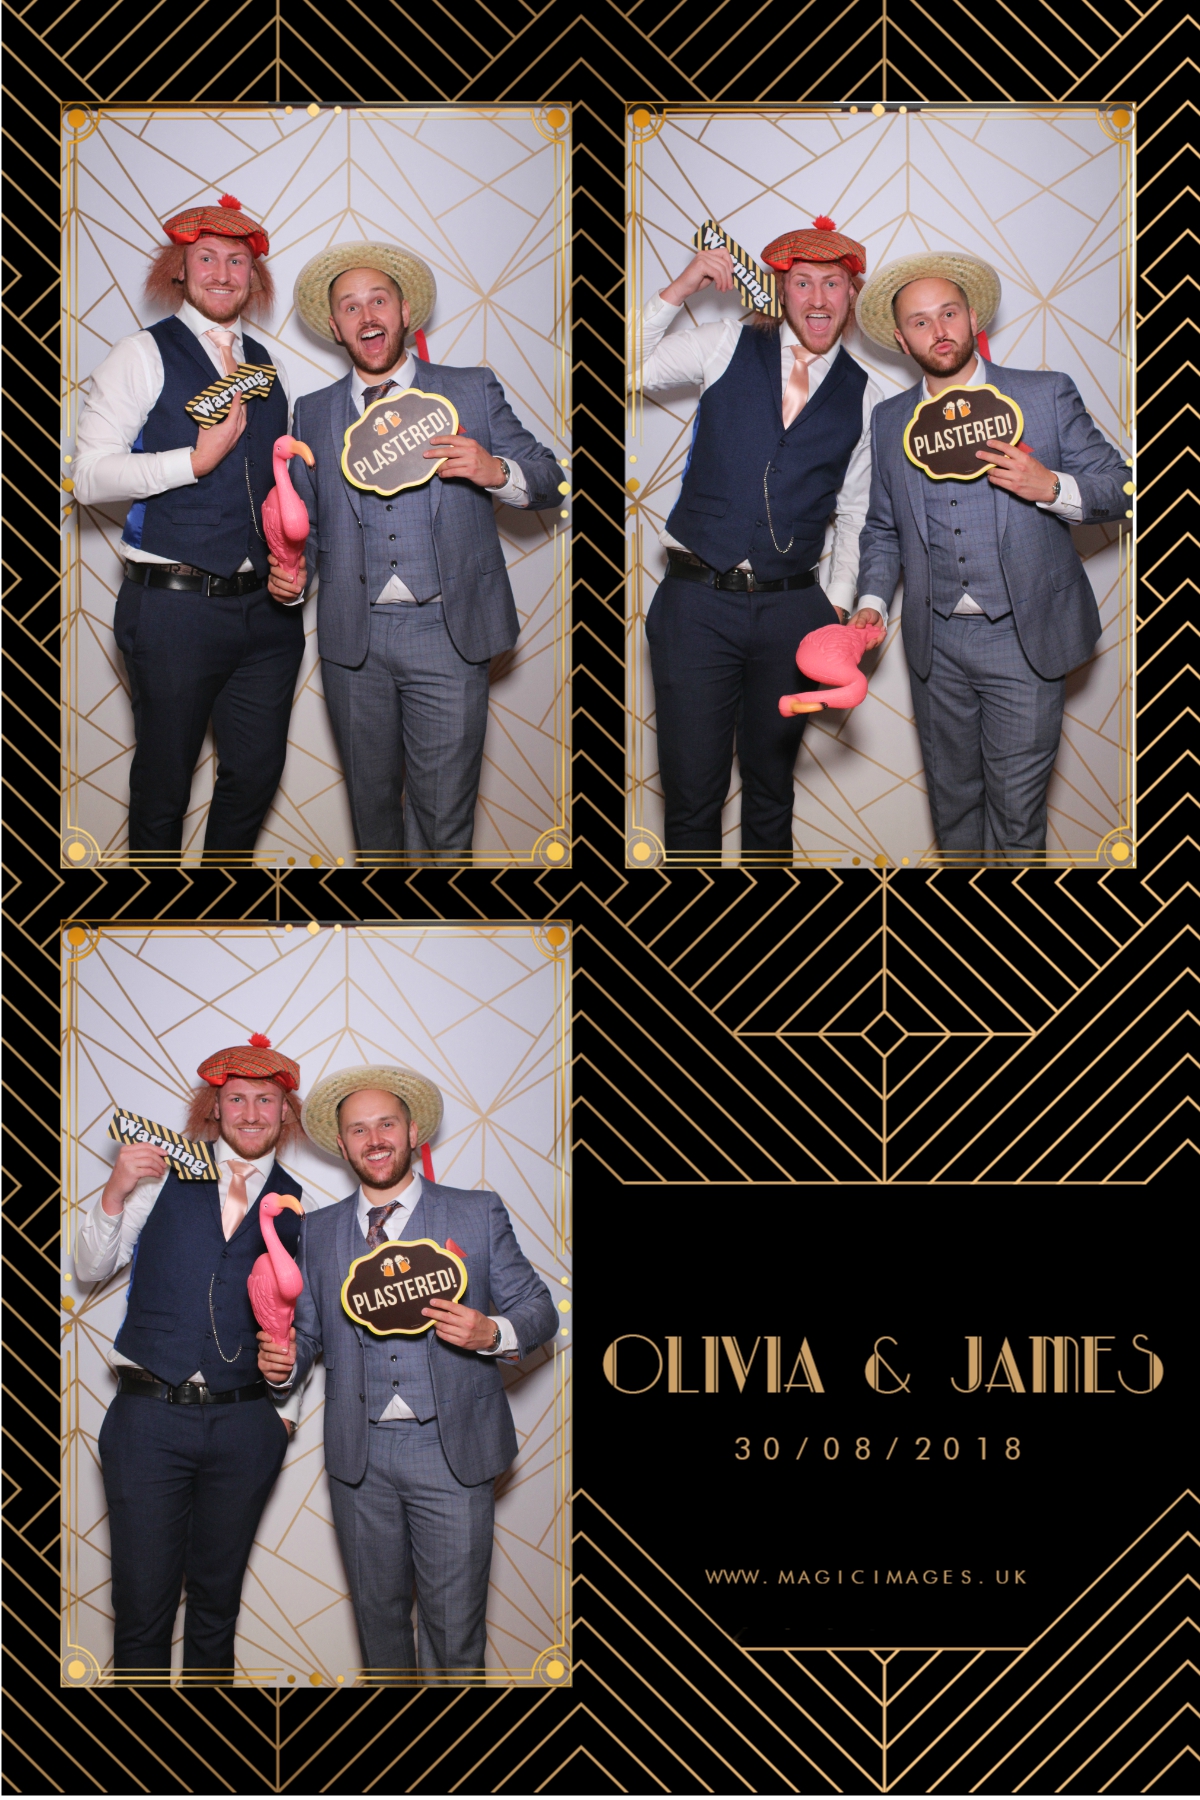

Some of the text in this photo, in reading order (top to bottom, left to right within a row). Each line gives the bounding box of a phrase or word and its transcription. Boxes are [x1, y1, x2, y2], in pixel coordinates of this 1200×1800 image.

[703, 227, 772, 308] Wning
[193, 371, 269, 417] Warning
[353, 408, 451, 481] PLASTERED!
[913, 413, 1014, 458] PLASTERED!
[119, 1116, 208, 1176] Warning
[352, 1267, 458, 1315] PLASTERED!
